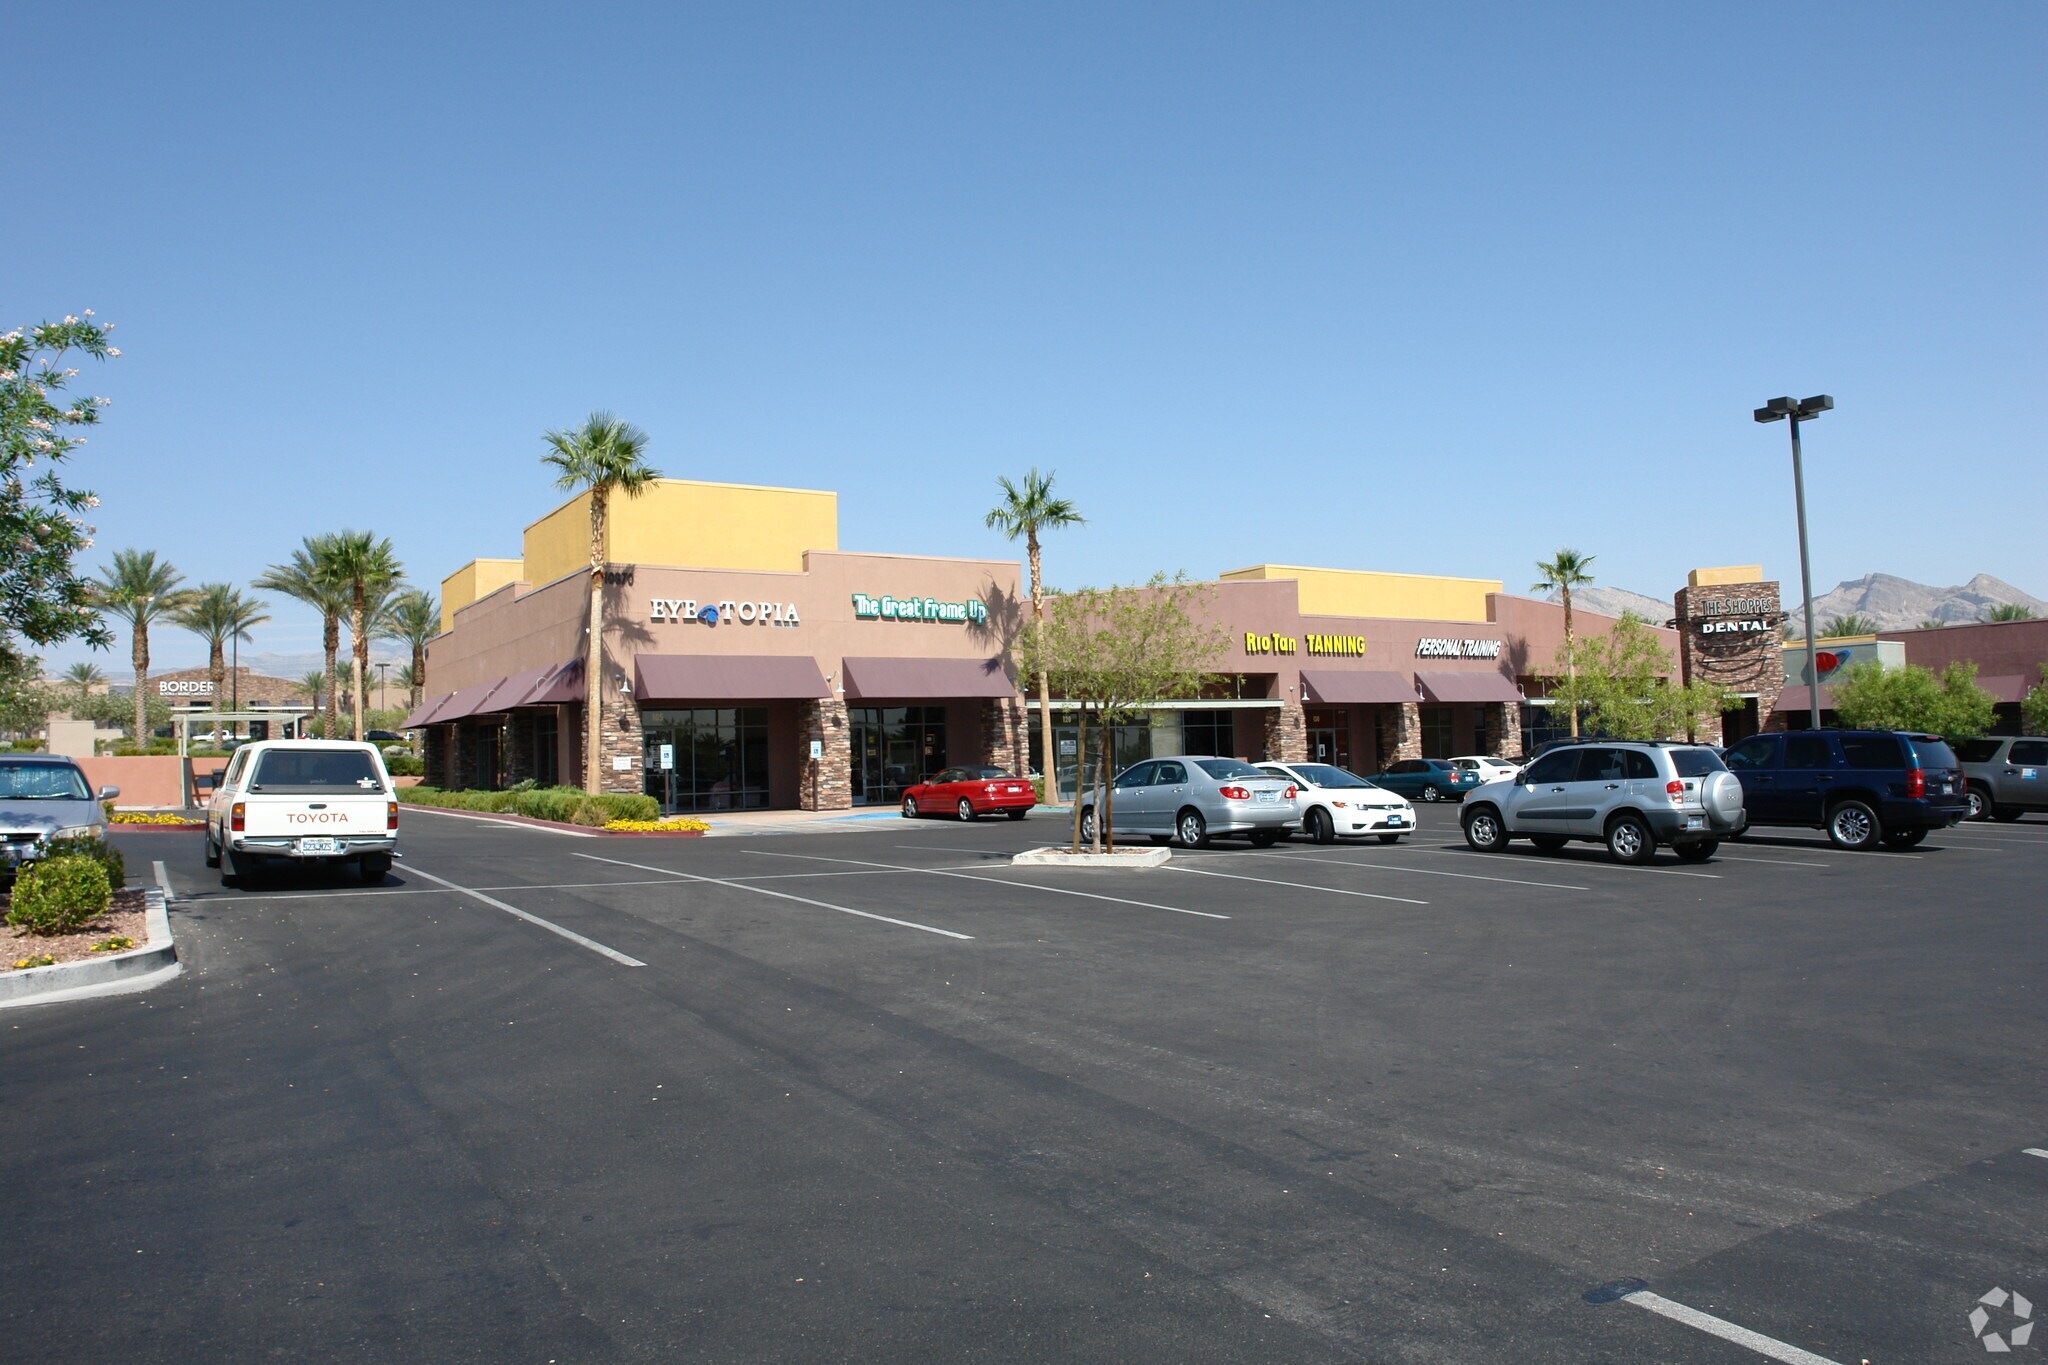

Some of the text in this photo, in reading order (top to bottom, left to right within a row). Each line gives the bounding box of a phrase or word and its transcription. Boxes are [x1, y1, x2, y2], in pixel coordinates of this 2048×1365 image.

[650, 598, 800, 622] EYE TOPIA
[852, 593, 988, 625] The Great Frame Up
[1701, 598, 1773, 616] THE SHOPPES
[1702, 621, 1772, 634] DENTAL
[1271, 632, 1297, 652] Tan
[1305, 634, 1366, 654] TANNING
[1416, 638, 1501, 657] PERSONAL TRAINING
[159, 680, 214, 692] BORDER
[286, 813, 349, 823] TOYOTA
